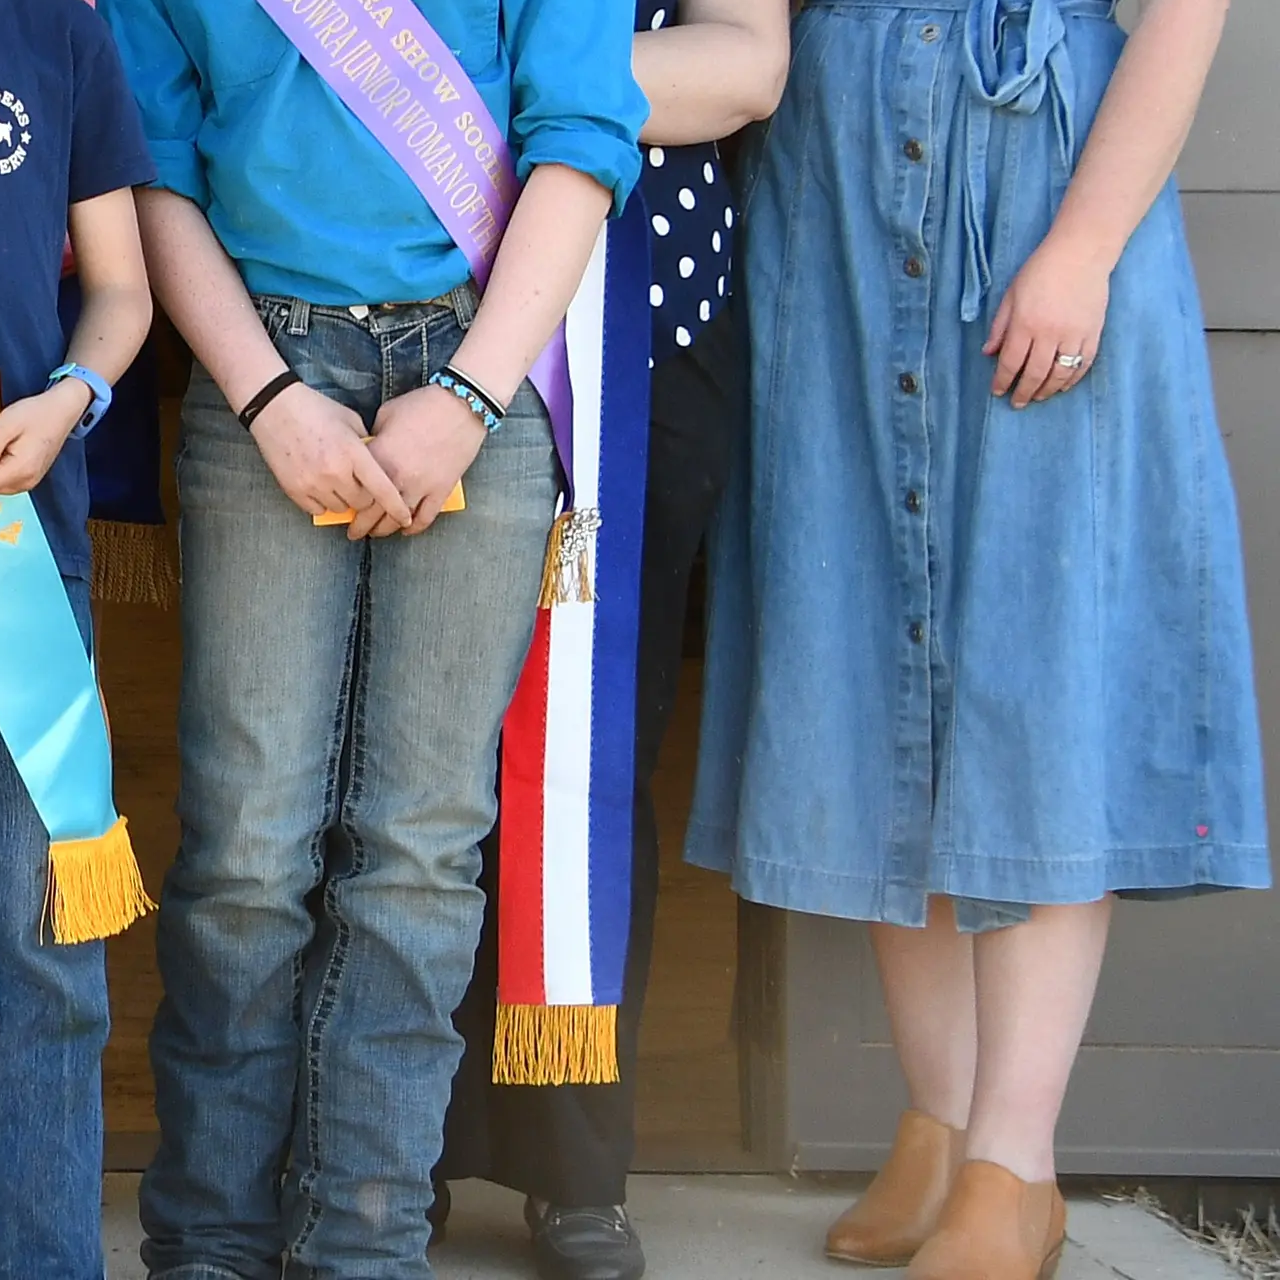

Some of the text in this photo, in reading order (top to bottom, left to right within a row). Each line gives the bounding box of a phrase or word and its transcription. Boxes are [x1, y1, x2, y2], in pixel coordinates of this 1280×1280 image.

[329, 39, 412, 120] JUNIOR
[393, 100, 470, 195] WOMAN
[450, 182, 487, 218] OF
[392, 28, 461, 104] SHOW
